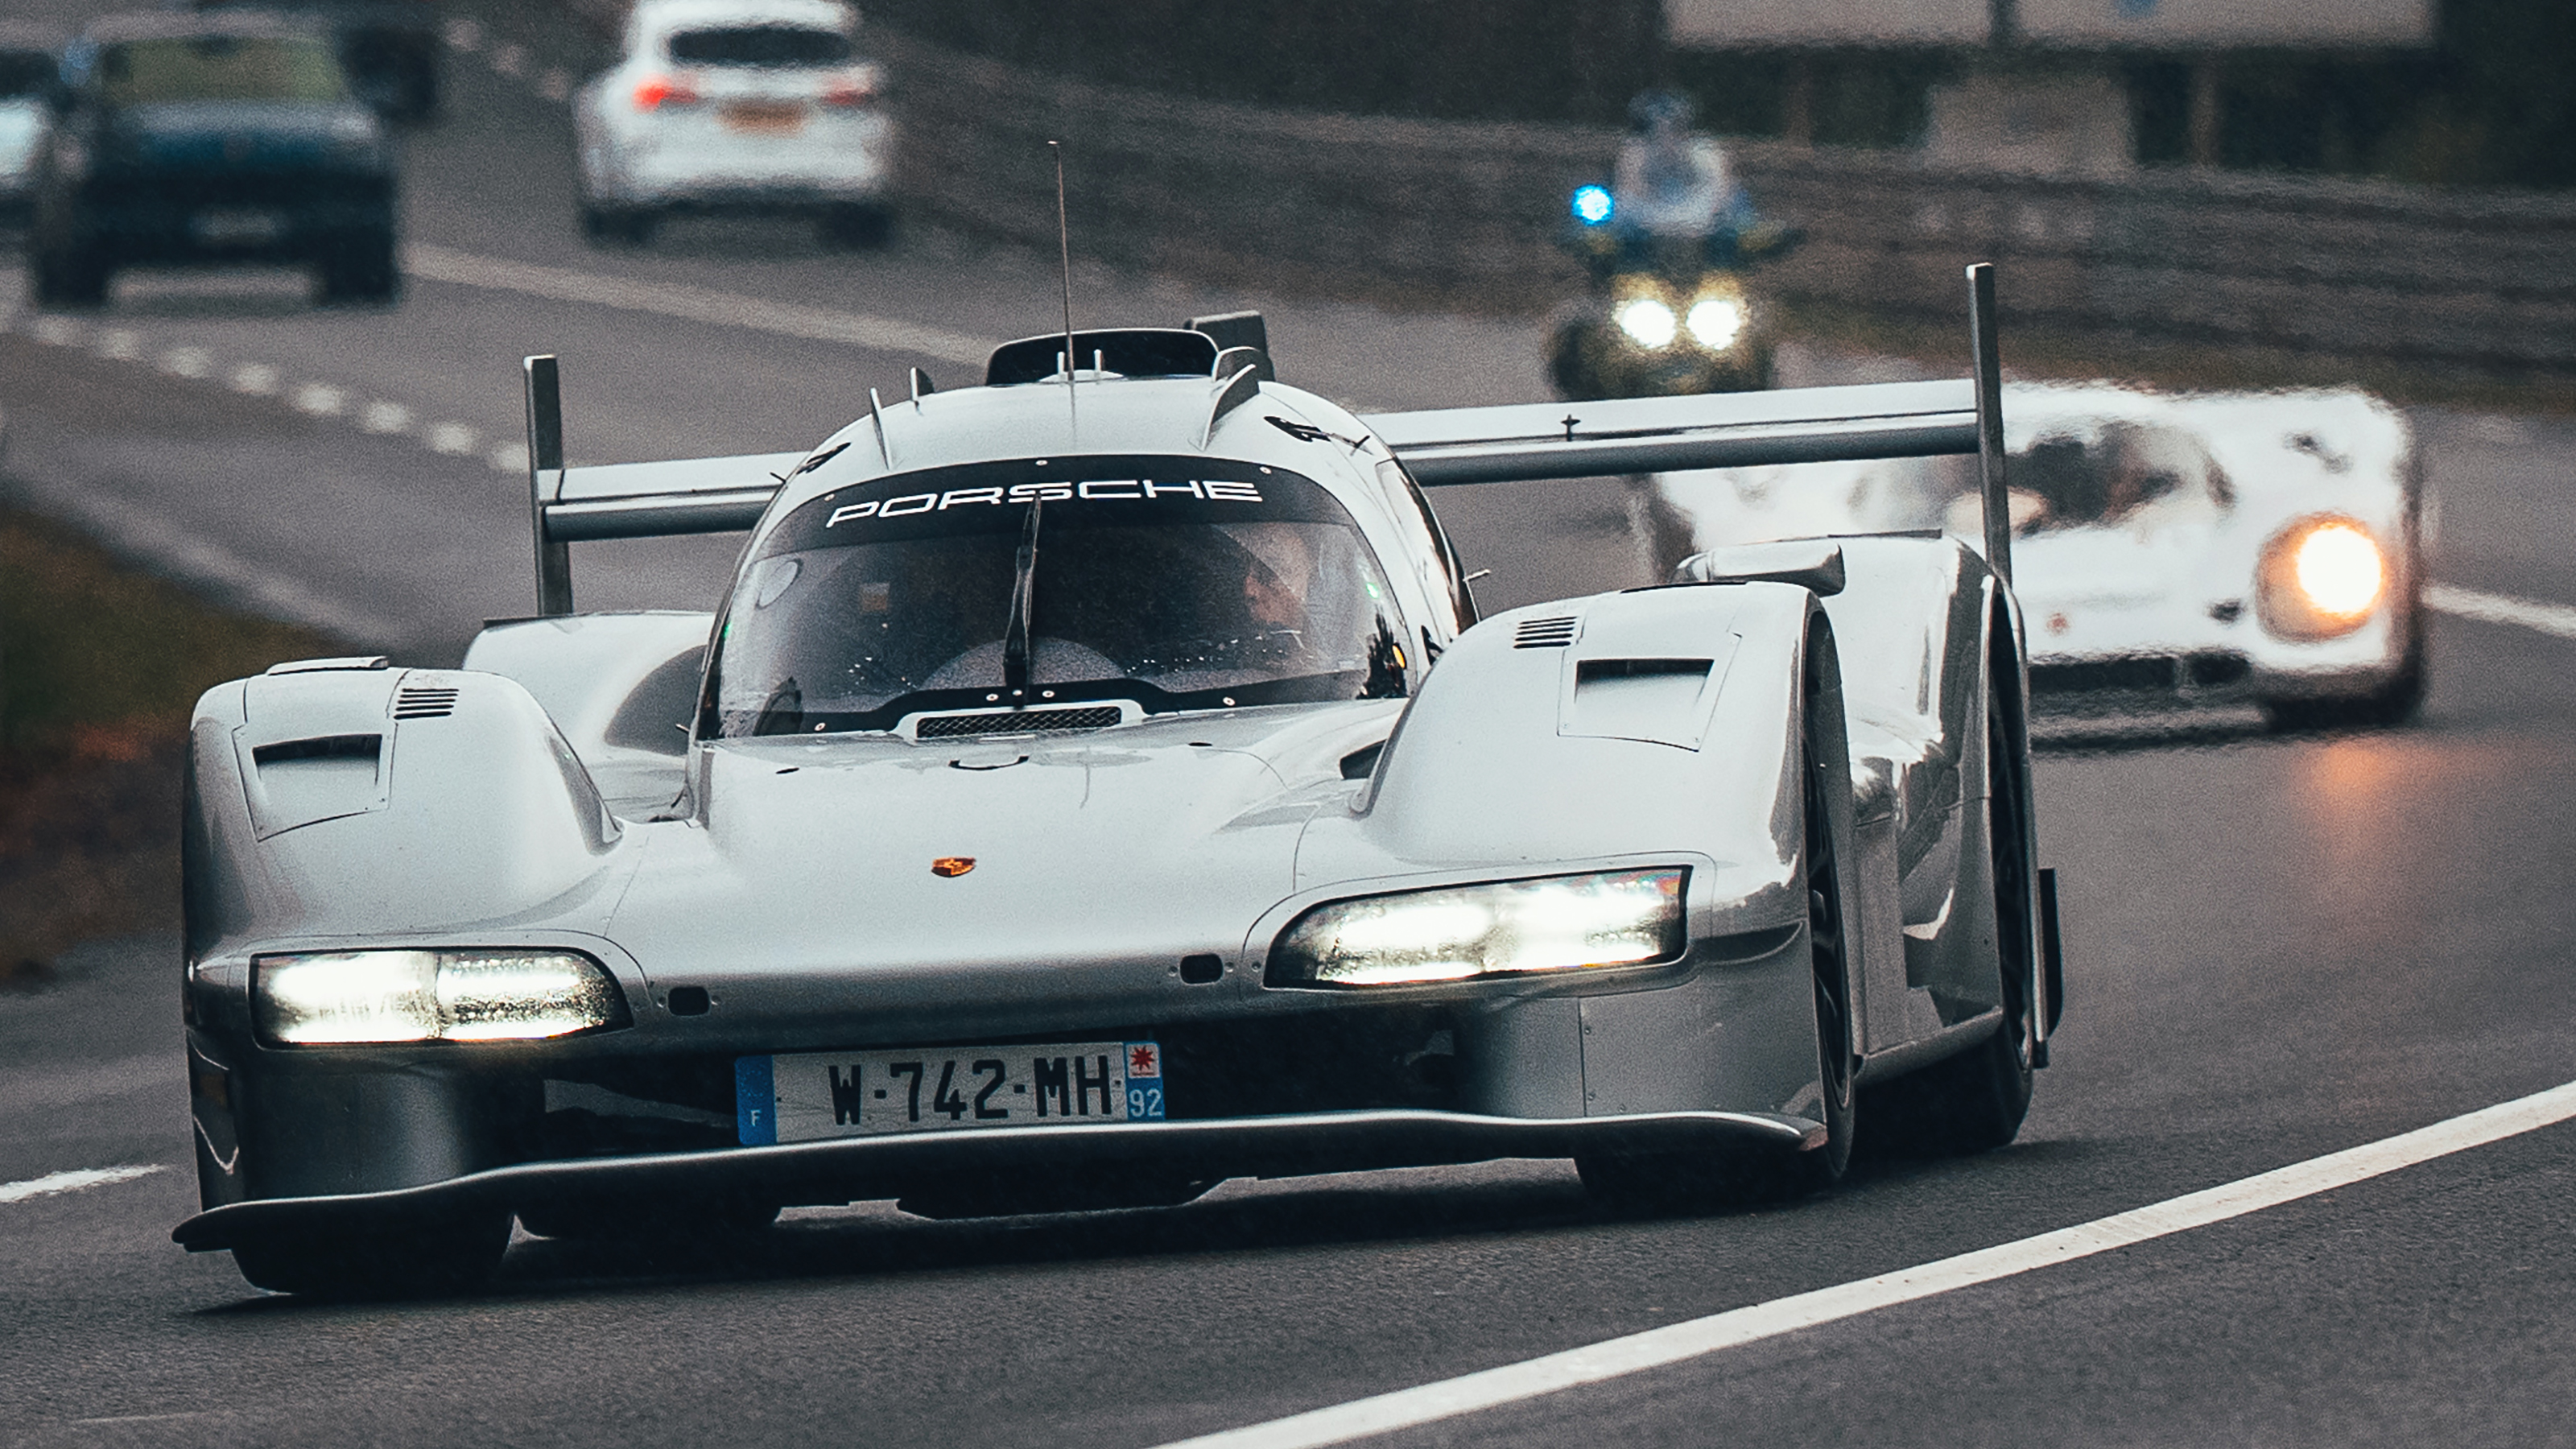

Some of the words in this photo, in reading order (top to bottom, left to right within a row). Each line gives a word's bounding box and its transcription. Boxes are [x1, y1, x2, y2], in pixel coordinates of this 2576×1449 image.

[825, 479, 1263, 528] PORSCHE
[828, 1055, 1113, 1125] W-742-MH
[1129, 1088, 1163, 1117] 92
[750, 1110, 762, 1127] F
